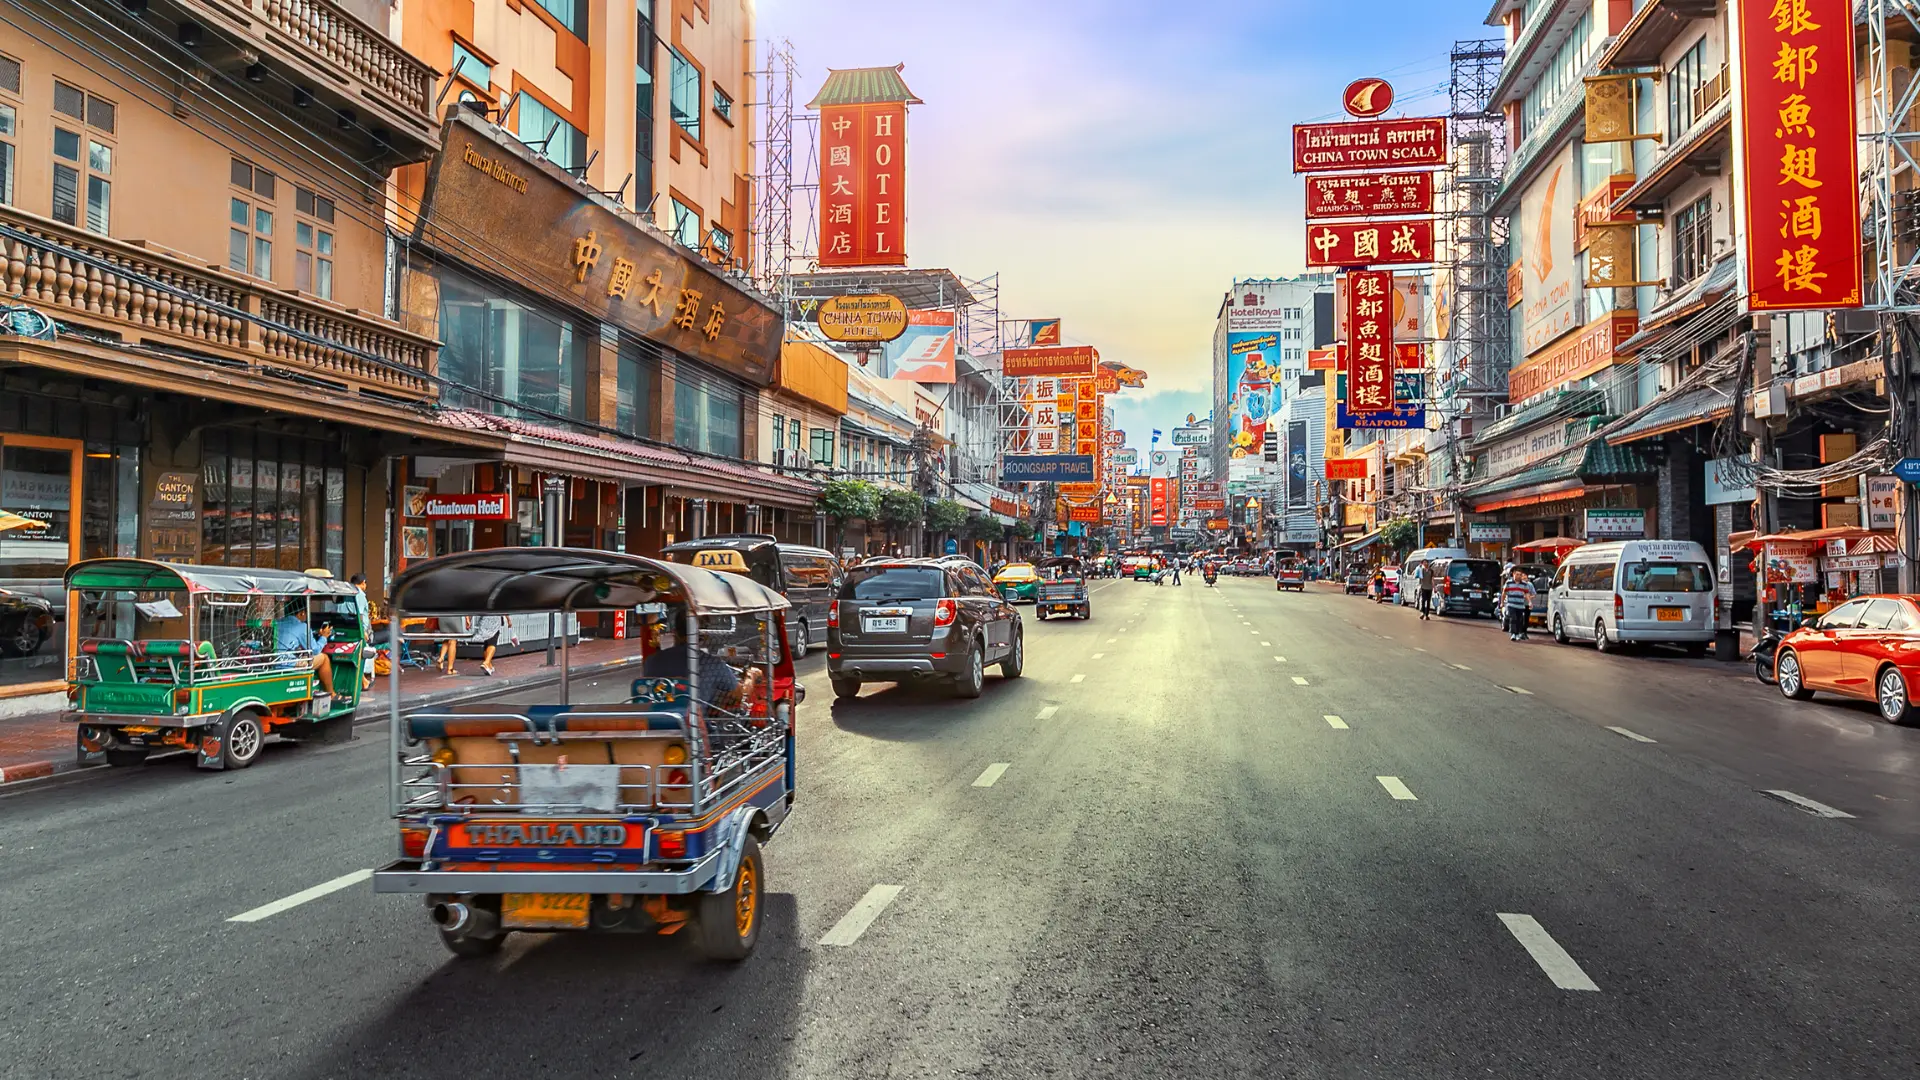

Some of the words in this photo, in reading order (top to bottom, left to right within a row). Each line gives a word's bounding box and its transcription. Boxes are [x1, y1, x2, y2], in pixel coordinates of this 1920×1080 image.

[1302, 151, 1344, 164] CHINA
[1348, 149, 1388, 162] TOWN
[1391, 146, 1437, 160] SCALA
[829, 114, 853, 256] 中國大酒店
[873, 114, 893, 254] HOTEL
[1313, 225, 1422, 263] 中國城
[574, 230, 726, 343] 中國大酒店
[823, 311, 861, 325] CHINA
[866, 310, 903, 325] TOWN
[1230, 308, 1255, 317] Hotel
[1255, 308, 1281, 319] Royal
[843, 326, 882, 337] HOTEL
[1355, 276, 1387, 407] 銀都魚翅酒樓
[1036, 380, 1054, 450] 振成豐
[1354, 419, 1408, 427] SEAFOOD
[1060, 461, 1091, 474] TRAVEL
[158, 482, 194, 494] CANTON
[160, 493, 187, 502] HOUSE
[426, 499, 477, 515] Chinatown
[477, 497, 504, 515] Hotel
[16, 510, 53, 519] CANTON
[700, 553, 733, 566] TAXI
[464, 824, 627, 846] THAILAND
